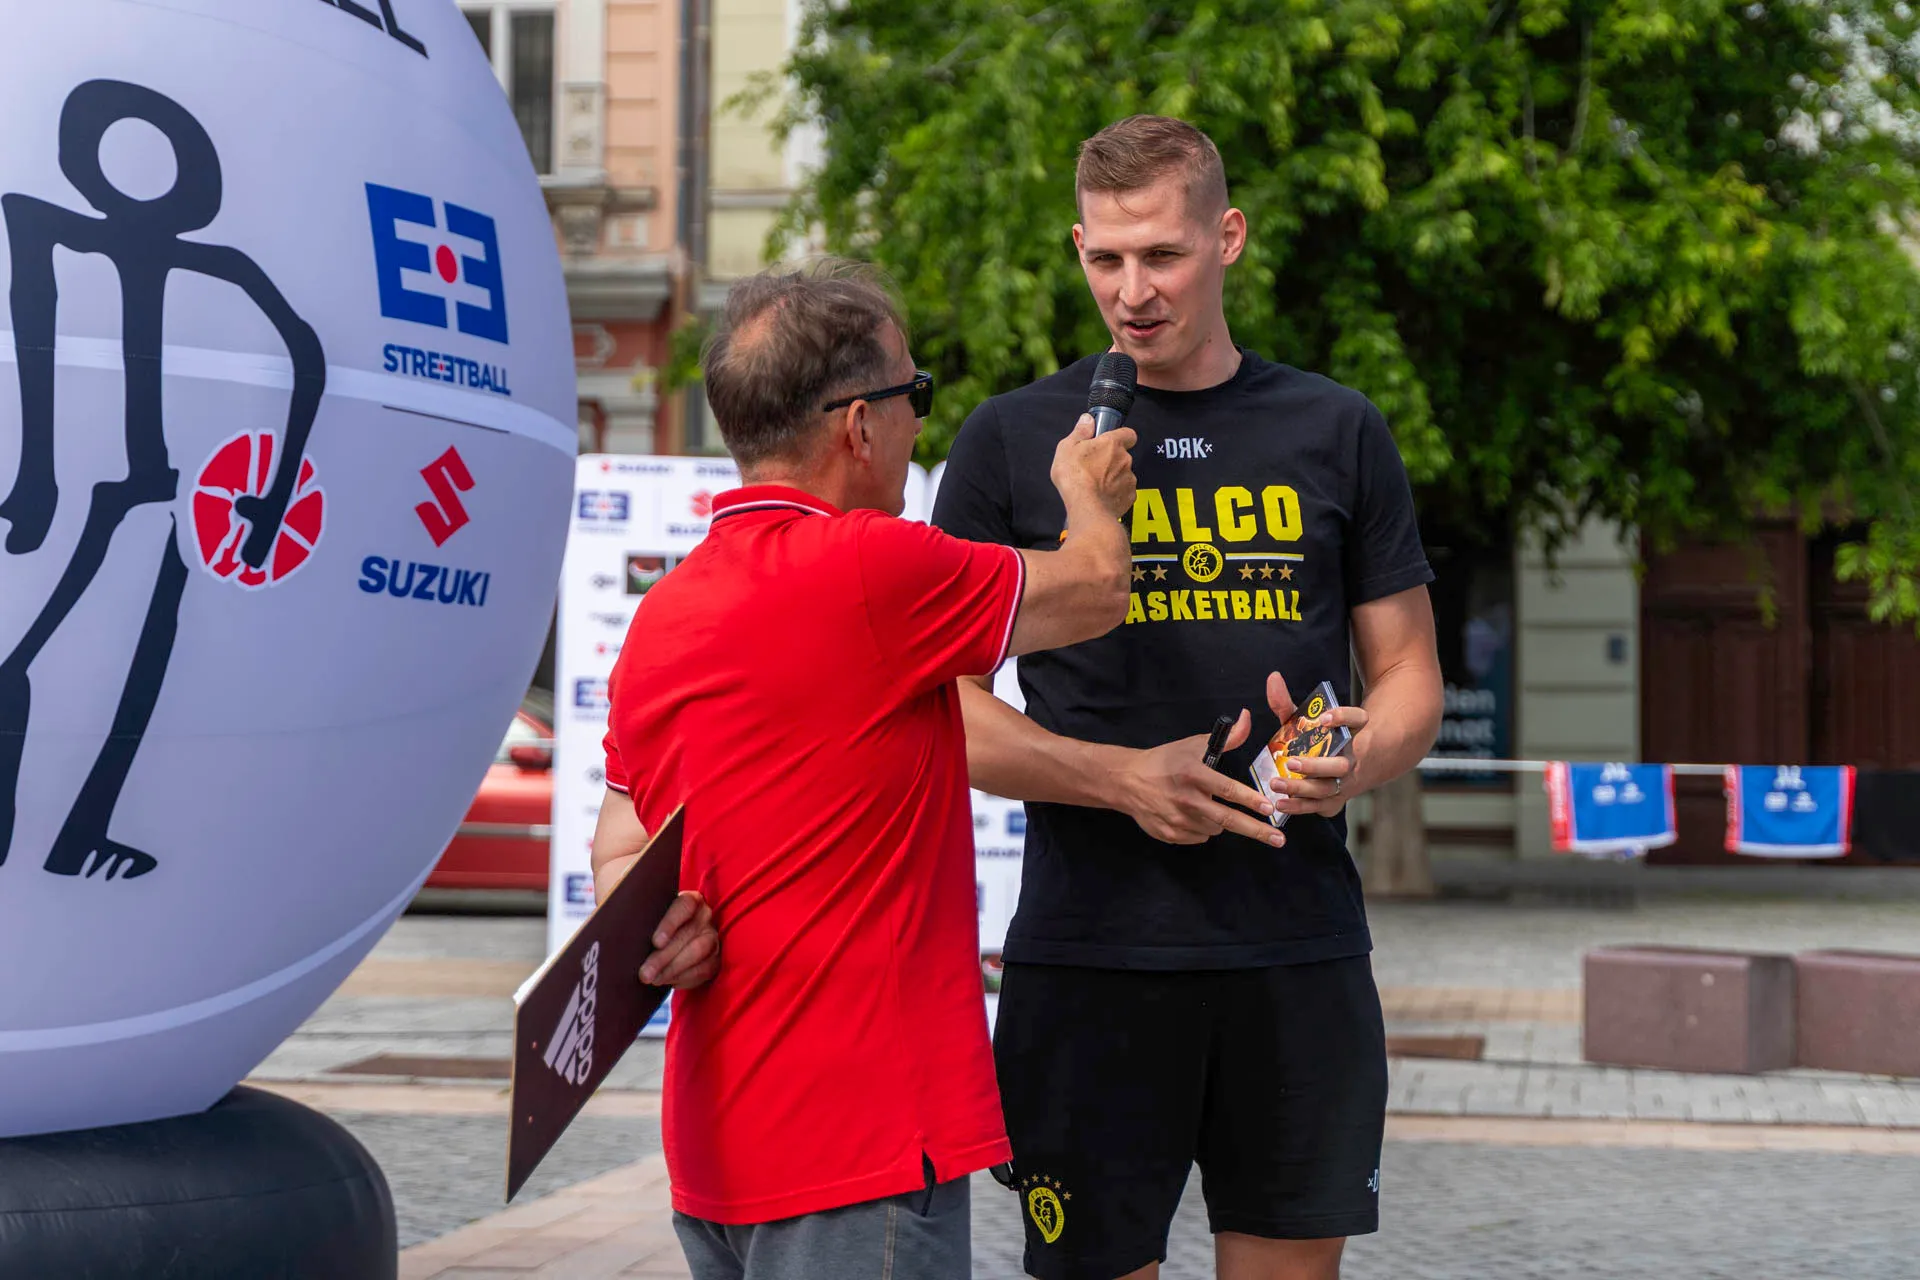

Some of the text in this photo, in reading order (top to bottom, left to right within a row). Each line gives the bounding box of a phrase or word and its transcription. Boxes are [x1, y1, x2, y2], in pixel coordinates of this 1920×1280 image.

[1131, 485, 1304, 543] ALCO
[358, 555, 490, 607] SUZUKI
[1125, 589, 1302, 625] ASKETBALL
[577, 941, 600, 1086] adidas
